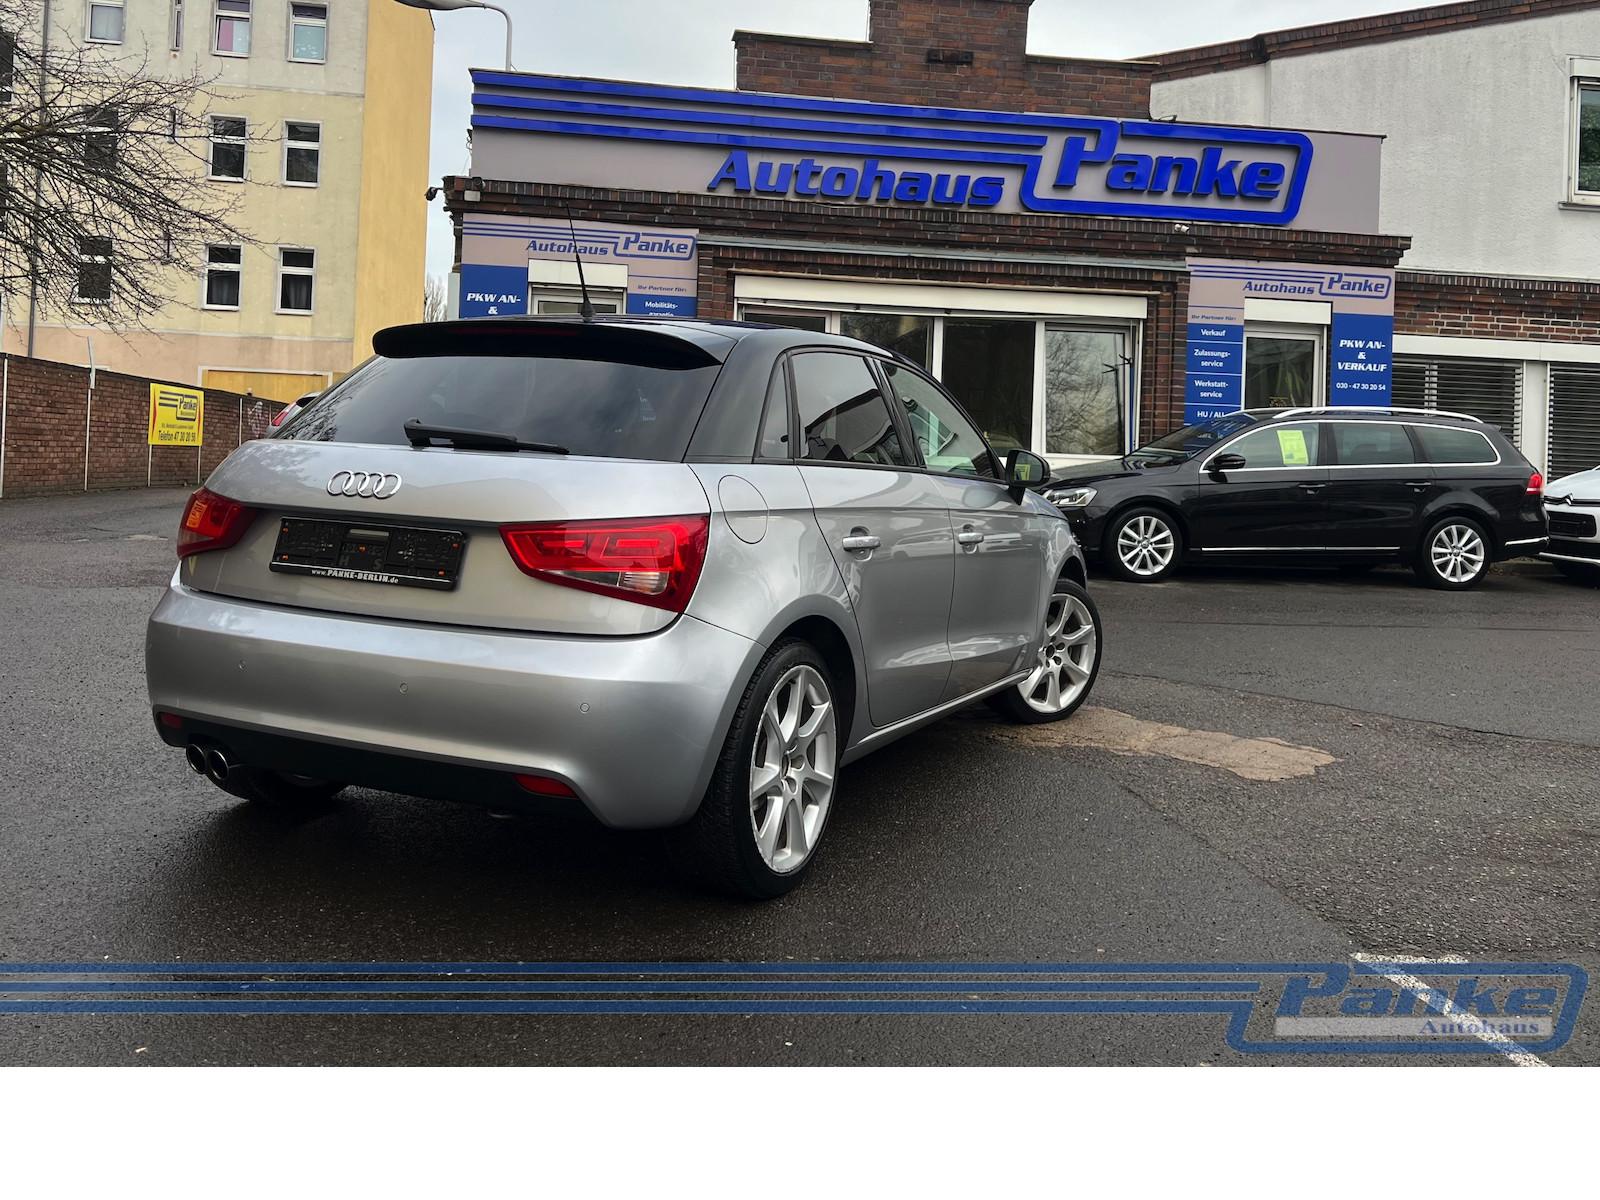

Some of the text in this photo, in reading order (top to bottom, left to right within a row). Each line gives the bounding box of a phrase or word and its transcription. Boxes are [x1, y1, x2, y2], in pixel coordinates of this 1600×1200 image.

[706, 125, 1286, 206] Autohaus Panke
[526, 232, 689, 256] Autohaus Panke
[1243, 272, 1385, 295] Autohaus Panke
[466, 292, 521, 303] PKW AN-
[644, 301, 679, 310] Mobilitäts-
[487, 306, 498, 315] &
[1201, 328, 1226, 337] Verkauf
[1339, 339, 1386, 349] PKW AN-
[1194, 349, 1231, 358] Zulassungs-
[1357, 351, 1367, 360] &
[1336, 361, 1388, 372] VERKAUF
[1194, 380, 1229, 388] Werkstatt-
[1200, 390, 1223, 398] service
[1197, 410, 1208, 418] HU
[311, 568, 399, 584] www.PANKE-BERLIN.de
